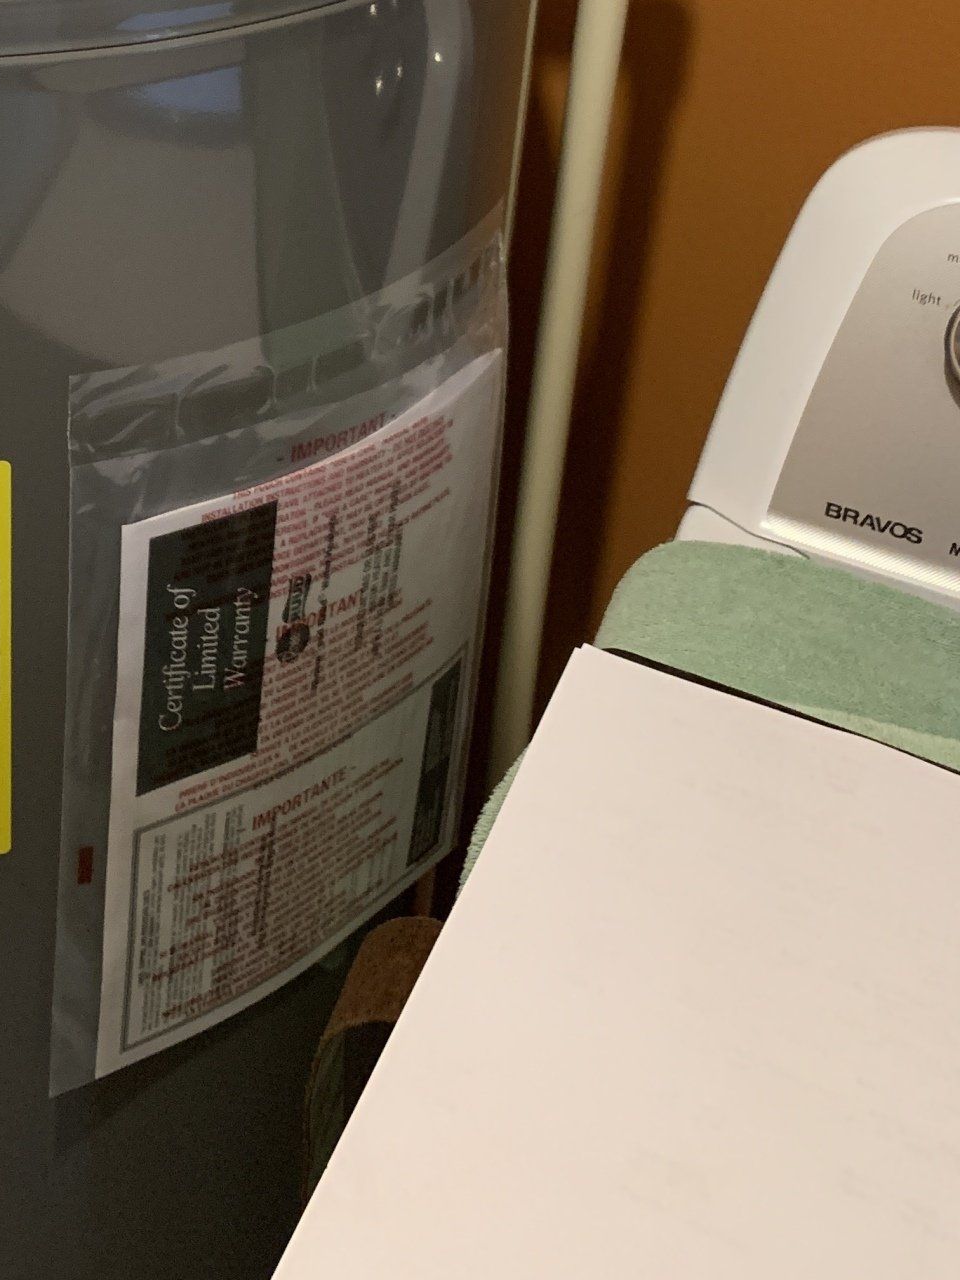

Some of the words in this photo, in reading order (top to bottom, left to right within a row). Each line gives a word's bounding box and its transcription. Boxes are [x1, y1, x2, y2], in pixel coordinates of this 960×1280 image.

[947, 252, 960, 263] m
[912, 288, 942, 306] light
[290, 410, 386, 464] IMPORTANT
[824, 501, 924, 545] BRAVOS
[166, 584, 197, 610] of
[192, 606, 221, 691] Limited
[223, 586, 259, 691] Warranty
[158, 616, 191, 731] Certificate
